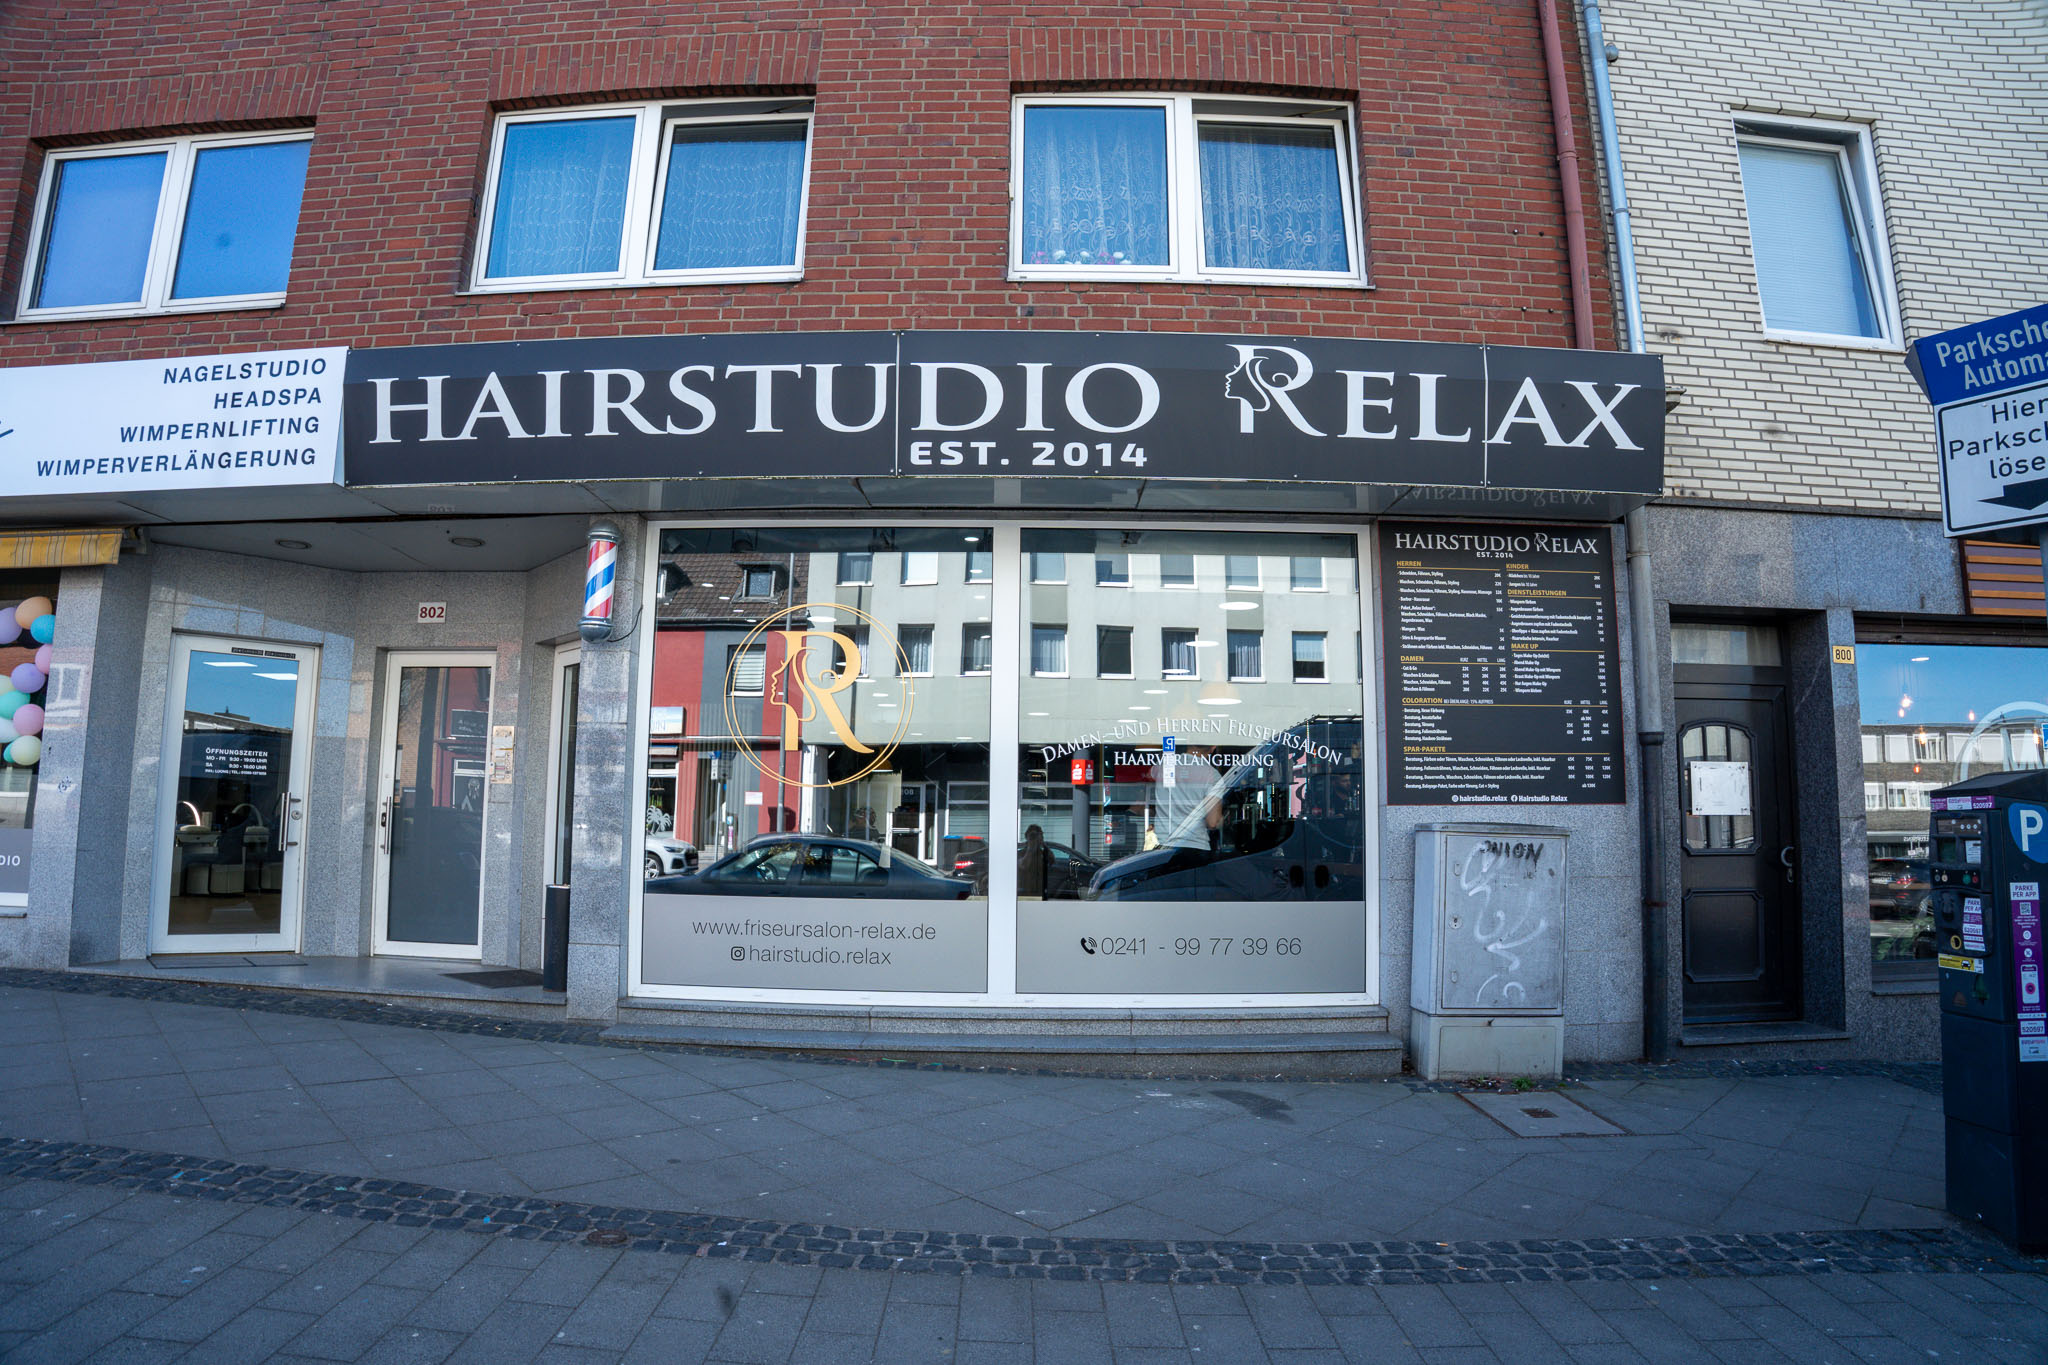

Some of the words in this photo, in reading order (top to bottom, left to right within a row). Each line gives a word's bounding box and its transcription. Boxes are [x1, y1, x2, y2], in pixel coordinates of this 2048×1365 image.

[164, 358, 326, 384] NAGELSTUDIO
[1964, 351, 2048, 390] Autom
[214, 387, 322, 409] HEADSPA
[368, 362, 1160, 444] HAIRSTUDIO
[1225, 344, 1644, 451] RELAX
[120, 416, 320, 443] WIMPERNLIFTING
[37, 447, 316, 477] WIMPERVERLÄNGERUNG
[910, 441, 1010, 466] EST.
[1032, 441, 1148, 467] 2014
[1990, 456, 2046, 478] löse
[1395, 533, 1530, 552] HAIRSTUDIO
[1534, 532, 1599, 554] RELAX
[420, 606, 444, 618] 802
[1835, 650, 1852, 660] 800
[206, 747, 268, 757] ÖFFNUNGSZEITEN
[1113, 721, 1150, 740] UND
[1156, 718, 1222, 733] HERREN
[1228, 720, 1342, 766] FRISEURSALON
[2020, 809, 2043, 851] P
[692, 918, 936, 940] www.friseursalon-relax.de
[749, 944, 892, 965] hairstudio.relax
[1100, 937, 1146, 955] 0241
[1174, 938, 1200, 956] 99
[1208, 938, 1234, 956] 77
[1242, 938, 1268, 956] 39
[1276, 938, 1302, 956] 66
